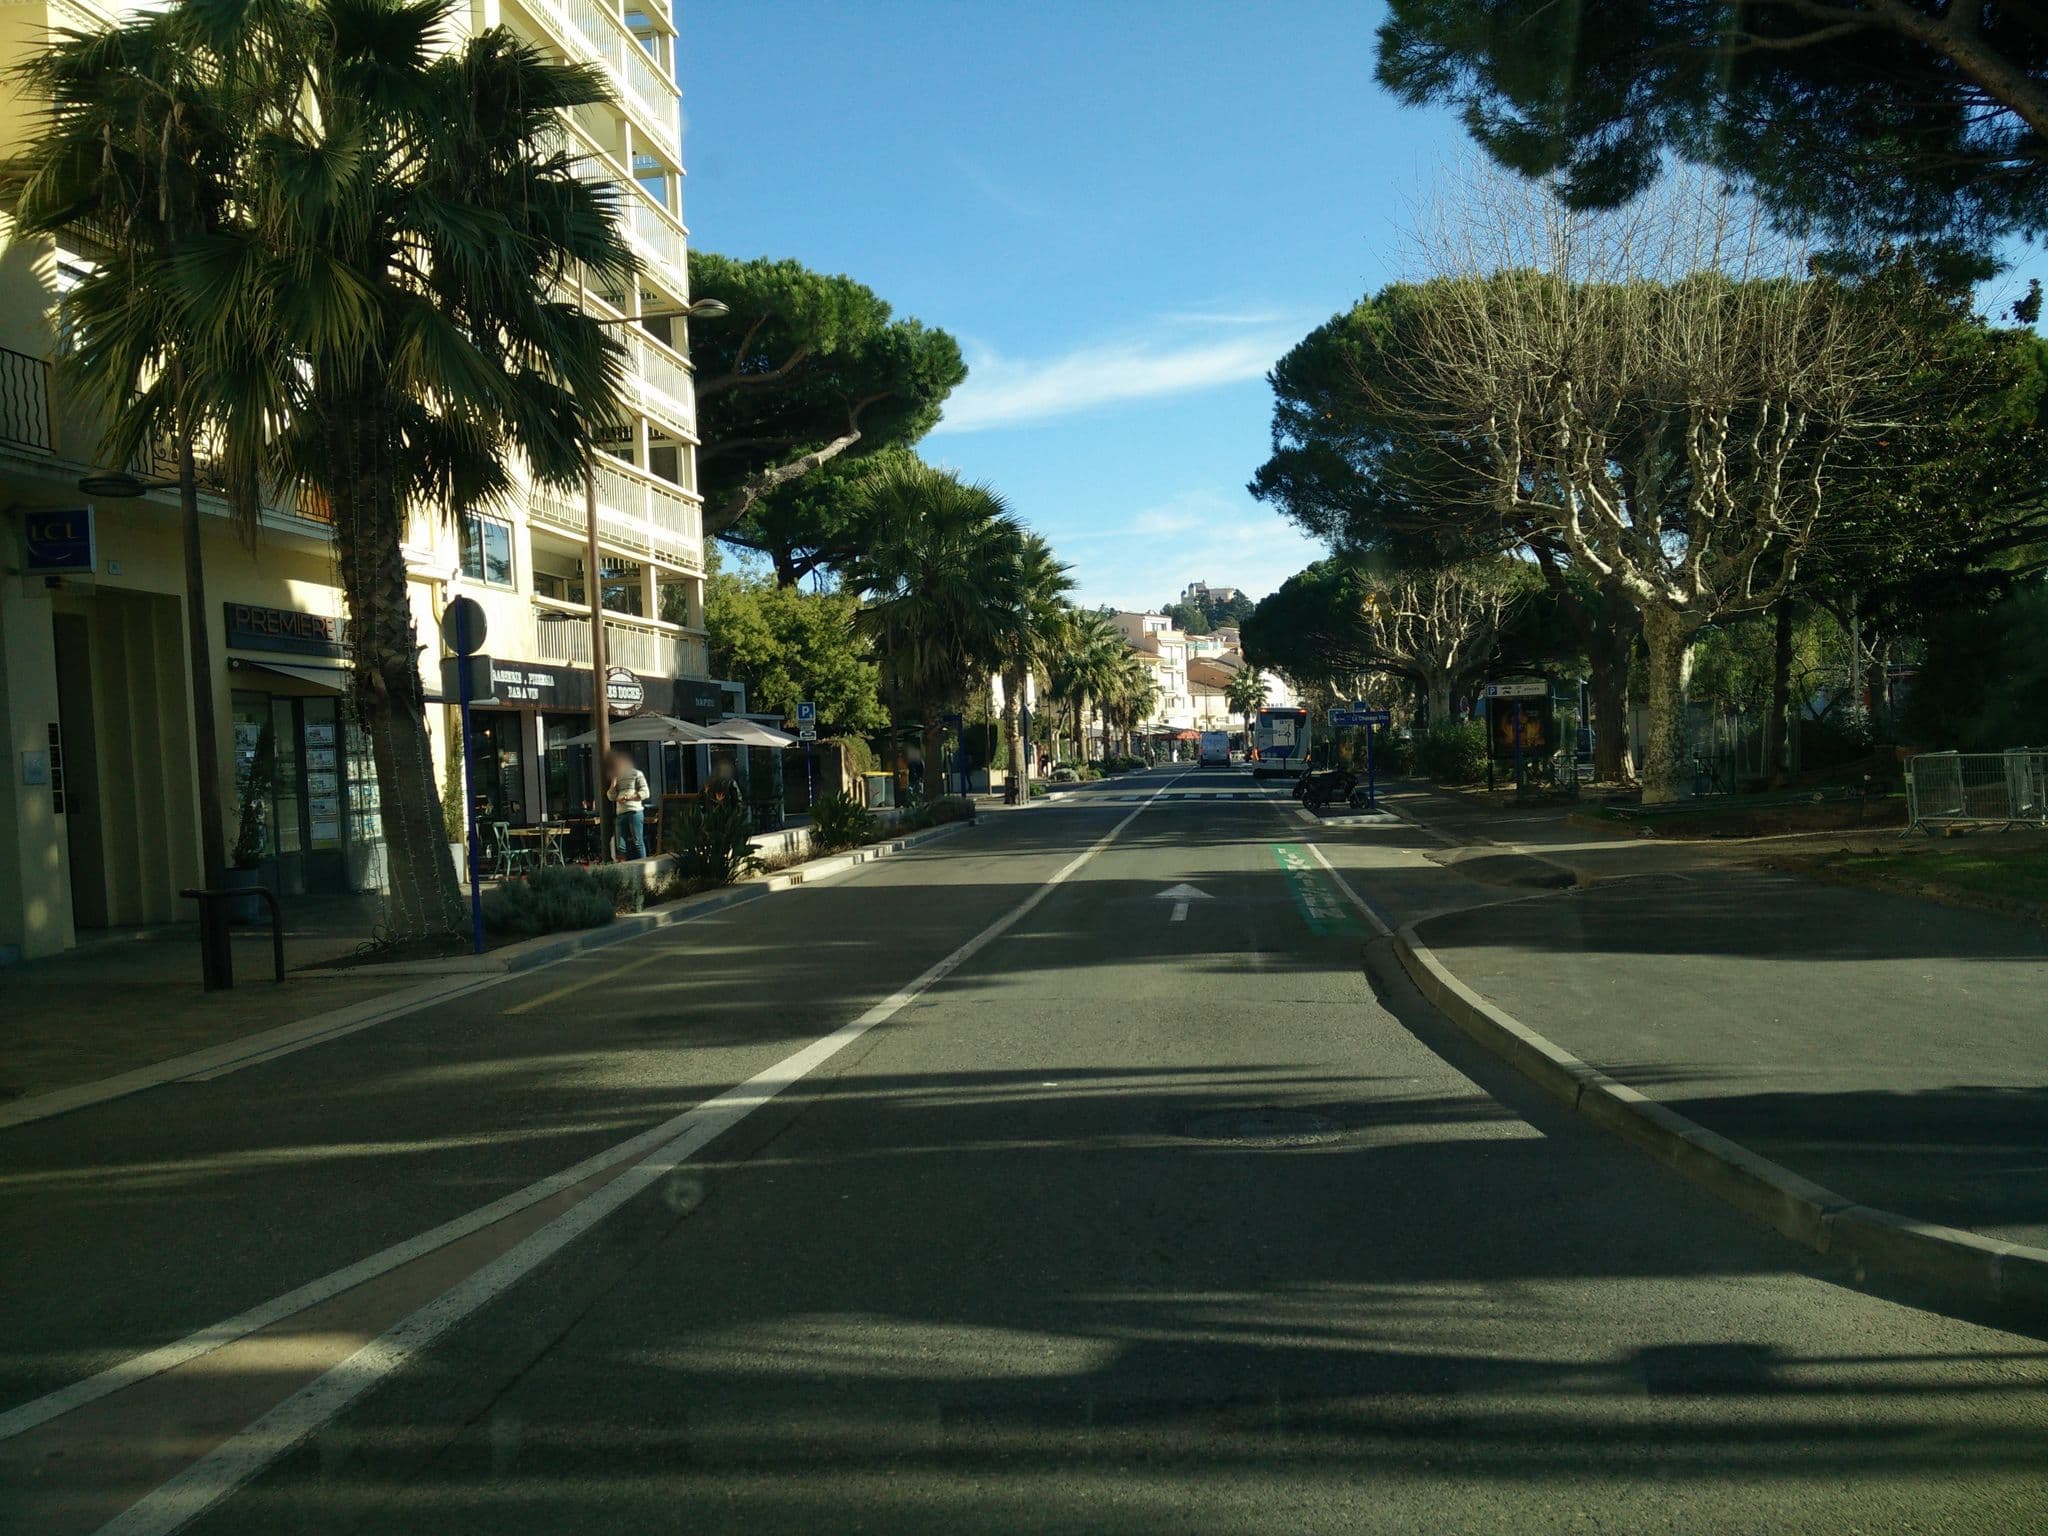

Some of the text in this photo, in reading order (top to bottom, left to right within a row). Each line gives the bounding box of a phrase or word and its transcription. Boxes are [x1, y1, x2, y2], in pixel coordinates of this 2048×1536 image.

[31, 521, 81, 542] LCL
[617, 686, 641, 699] DOCKS
[801, 705, 810, 717] P
